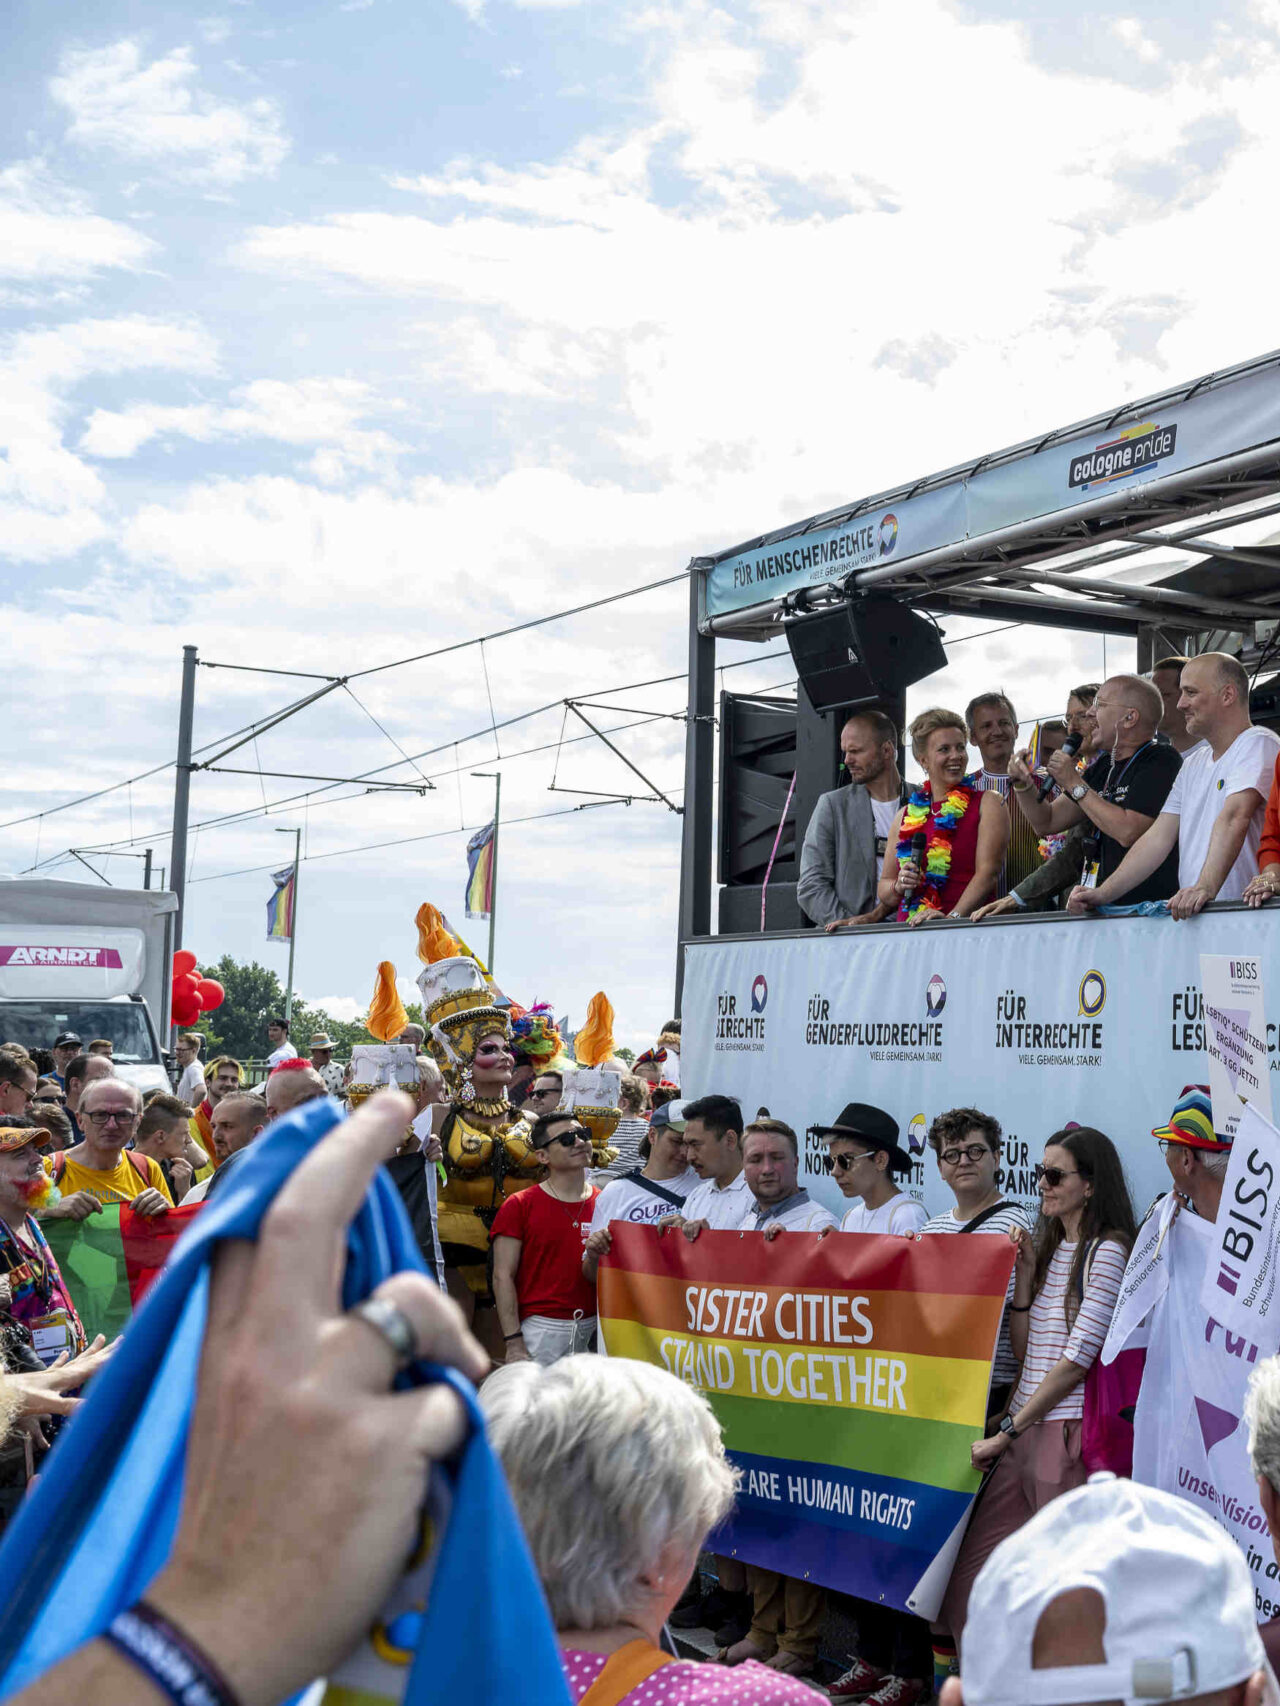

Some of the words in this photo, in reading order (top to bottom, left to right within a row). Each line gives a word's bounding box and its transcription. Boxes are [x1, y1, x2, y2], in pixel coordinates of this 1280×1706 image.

[1073, 446, 1132, 482] cologne
[1133, 431, 1171, 464] pride
[733, 560, 753, 589] FÜR
[756, 525, 874, 582] MENSCHENRECHTE
[6, 947, 101, 965] ARNDT
[1236, 961, 1258, 980] BISS
[718, 990, 736, 1016] FÜR
[807, 994, 830, 1022] FÜR
[997, 990, 1027, 1021] FÜR
[805, 1022, 943, 1047] GENDERFLUIDRECHTE
[995, 1023, 1103, 1050] INTERRECHTE
[1216, 1030, 1254, 1065] ERGÄNZUNG
[1231, 1022, 1267, 1055] SCHÜTZEN!
[1018, 1054, 1036, 1066] VIELE.
[1036, 1054, 1075, 1067] GEMEINSAM.
[1076, 1055, 1102, 1068] STARK!
[1228, 1059, 1238, 1073] GG
[1222, 1148, 1274, 1263] BISS
[685, 1286, 768, 1338] SISTER
[774, 1292, 874, 1345] CITIES
[659, 1336, 736, 1391] STAND
[742, 1347, 908, 1411] TOGETHER
[748, 1469, 782, 1501] ARE
[787, 1475, 855, 1516] HUMAN
[859, 1489, 916, 1531] RIGHTS
